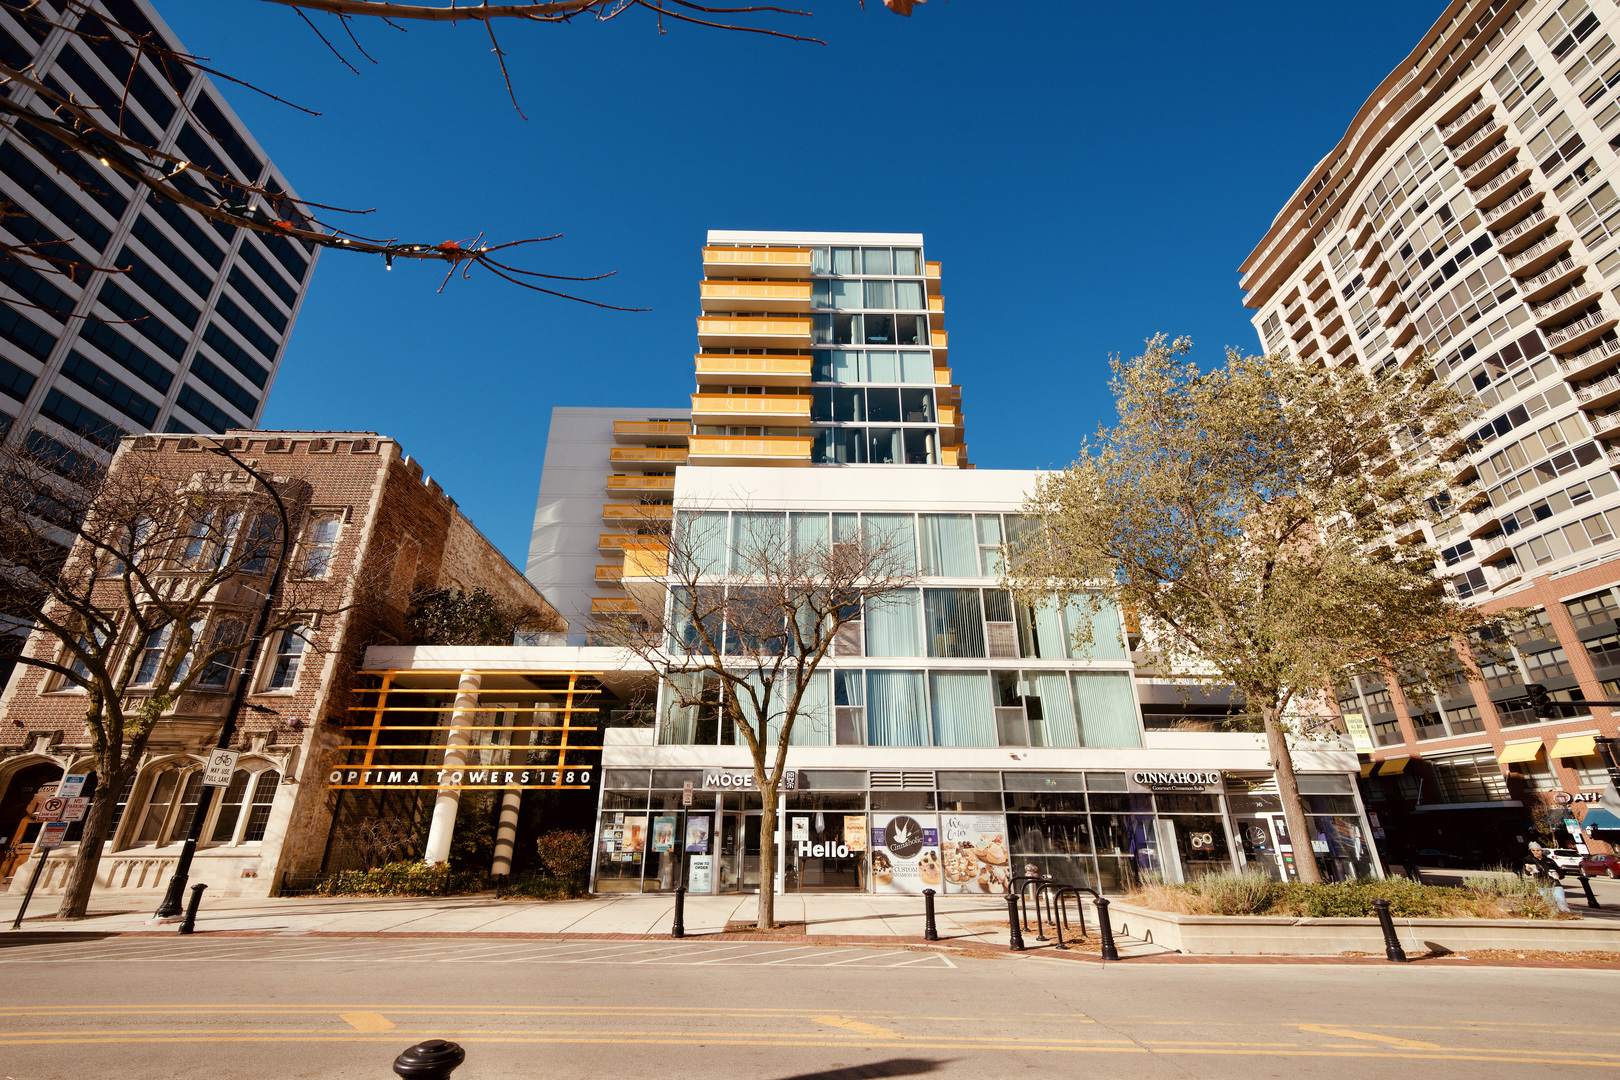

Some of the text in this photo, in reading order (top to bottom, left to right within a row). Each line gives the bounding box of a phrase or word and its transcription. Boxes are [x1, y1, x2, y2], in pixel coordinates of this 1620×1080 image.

[329, 771, 590, 783] OPTIMA TOWERS 1580
[706, 772, 752, 787] MÖGE
[1134, 772, 1219, 784] CINNAHOLIC
[1574, 793, 1597, 801] ATI
[798, 840, 854, 858] Hello.
